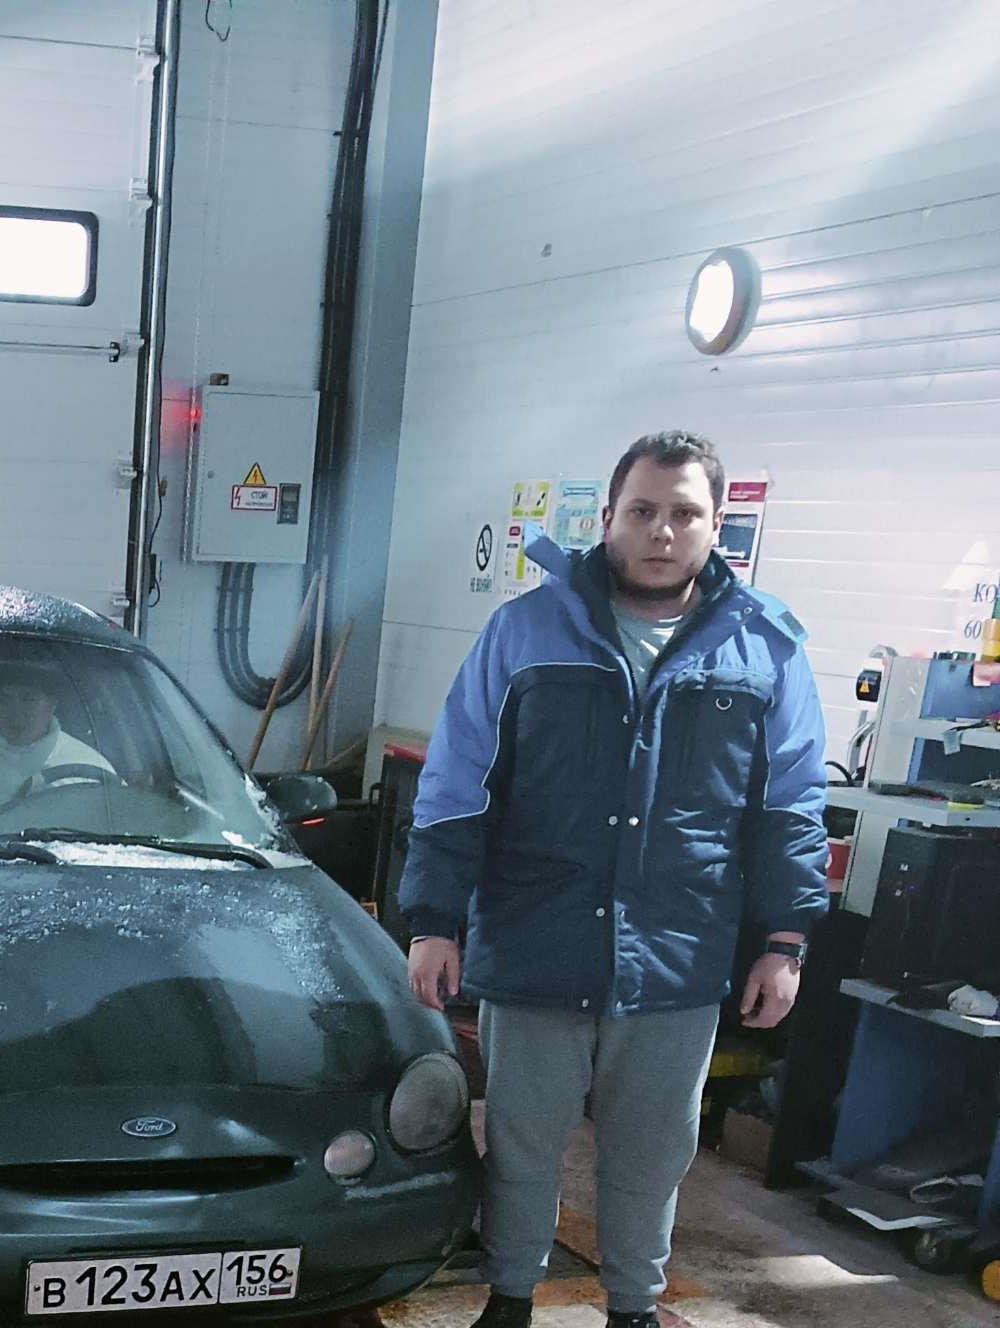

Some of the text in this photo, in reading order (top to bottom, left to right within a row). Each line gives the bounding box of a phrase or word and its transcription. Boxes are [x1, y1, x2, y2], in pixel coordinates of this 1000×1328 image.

[135, 1119, 164, 1132] Ford
[226, 1253, 286, 1287] 156
[236, 1284, 268, 1298] RUS
